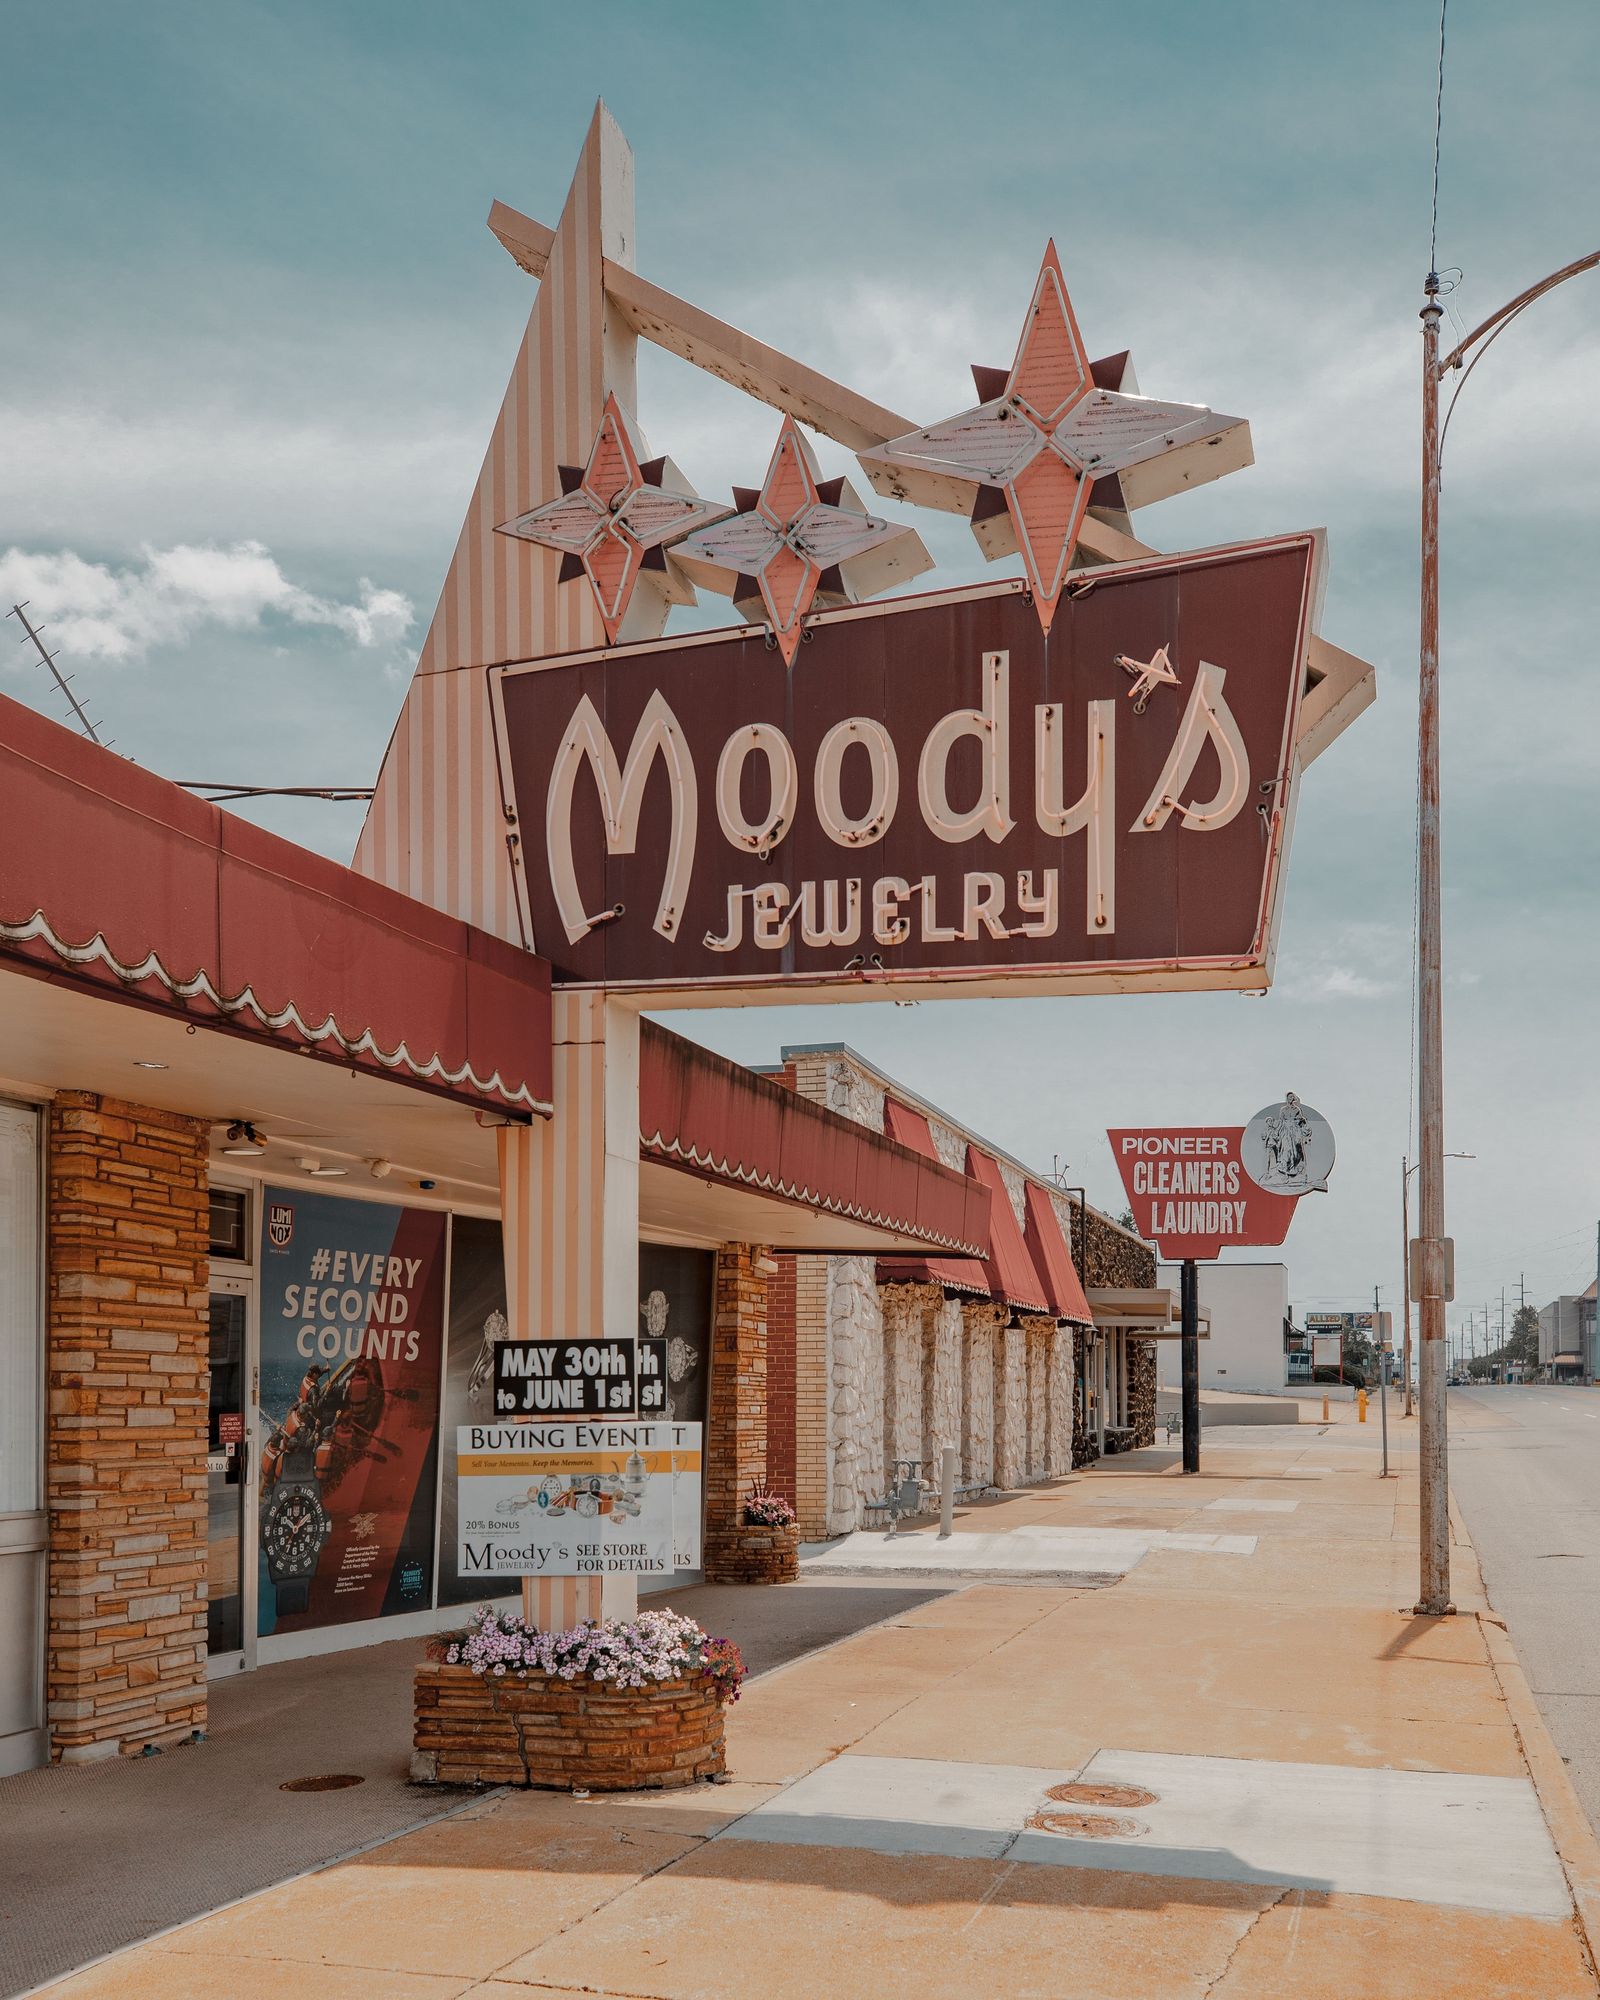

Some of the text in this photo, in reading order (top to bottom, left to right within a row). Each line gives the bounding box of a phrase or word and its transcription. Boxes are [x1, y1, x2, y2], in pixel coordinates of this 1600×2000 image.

[546, 646, 1251, 945] Moody's
[702, 867, 1059, 952] JEWELRY
[1122, 1137, 1229, 1155] PIONEER
[1133, 1161, 1240, 1195] CLEANERS
[271, 1207, 292, 1225] LUMI
[1151, 1201, 1247, 1234] LAUNDRY
[310, 1248, 423, 1289] #EVERY
[282, 1284, 409, 1324] SECOND
[1308, 1314, 1341, 1323] ALLIED
[297, 1325, 421, 1362] COUNTS
[501, 1344, 627, 1378] MAY 30th
[638, 1345, 658, 1375] th
[497, 1379, 632, 1410] to JUNE 1st
[641, 1380, 664, 1406] st
[471, 1427, 565, 1450] BUYING
[576, 1425, 656, 1448] EVENT
[484, 1460, 497, 1468] Your
[532, 1460, 548, 1468] Keep
[466, 1521, 520, 1529] 20% BONUS
[576, 1543, 648, 1557] SEE STORE
[497, 1562, 536, 1570] JEWELRY
[577, 1559, 605, 1572] FOR
[608, 1558, 665, 1571] DETAILS
